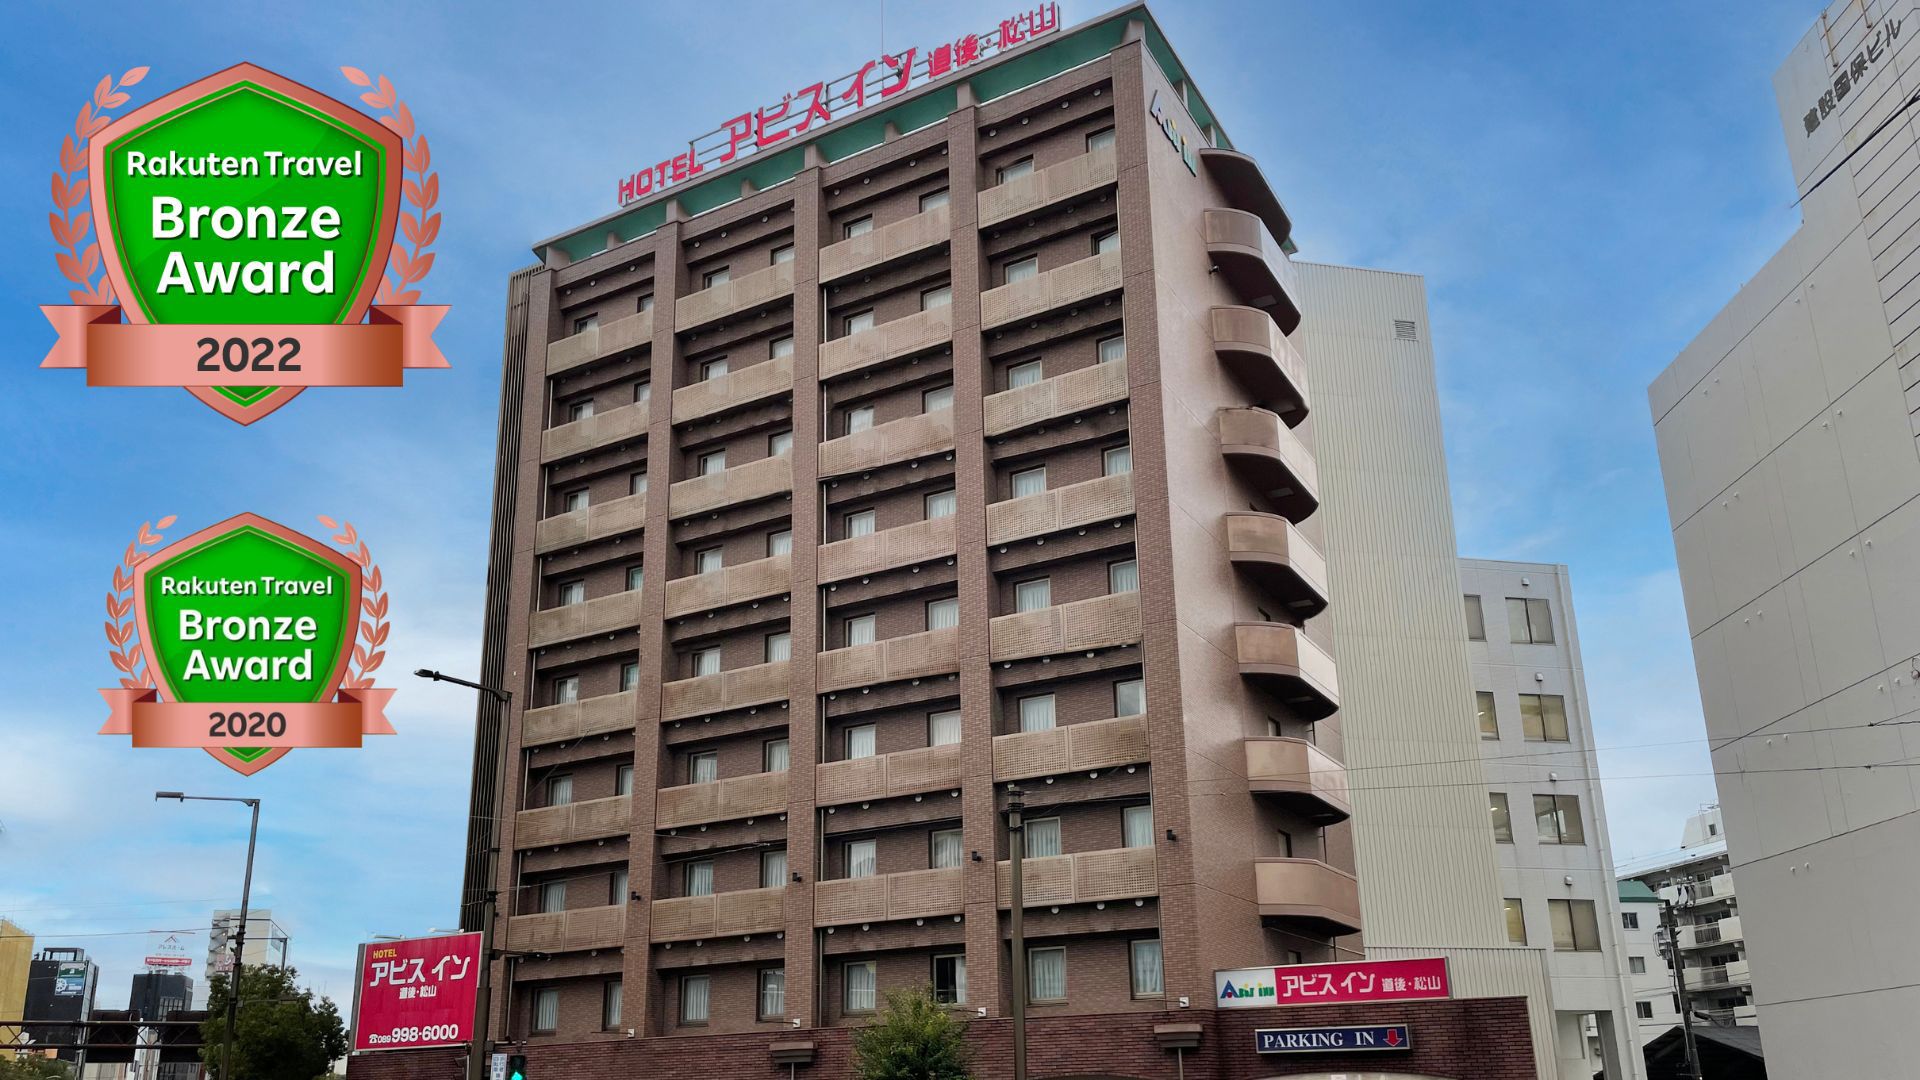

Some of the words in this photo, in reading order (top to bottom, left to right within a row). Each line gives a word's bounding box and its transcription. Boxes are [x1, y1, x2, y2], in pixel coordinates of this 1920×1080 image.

[618, 148, 704, 205] HOTEL
[373, 949, 397, 959] HOTEL
[1263, 1032, 1343, 1048] PARKING
[1355, 1031, 1374, 1046] IN
